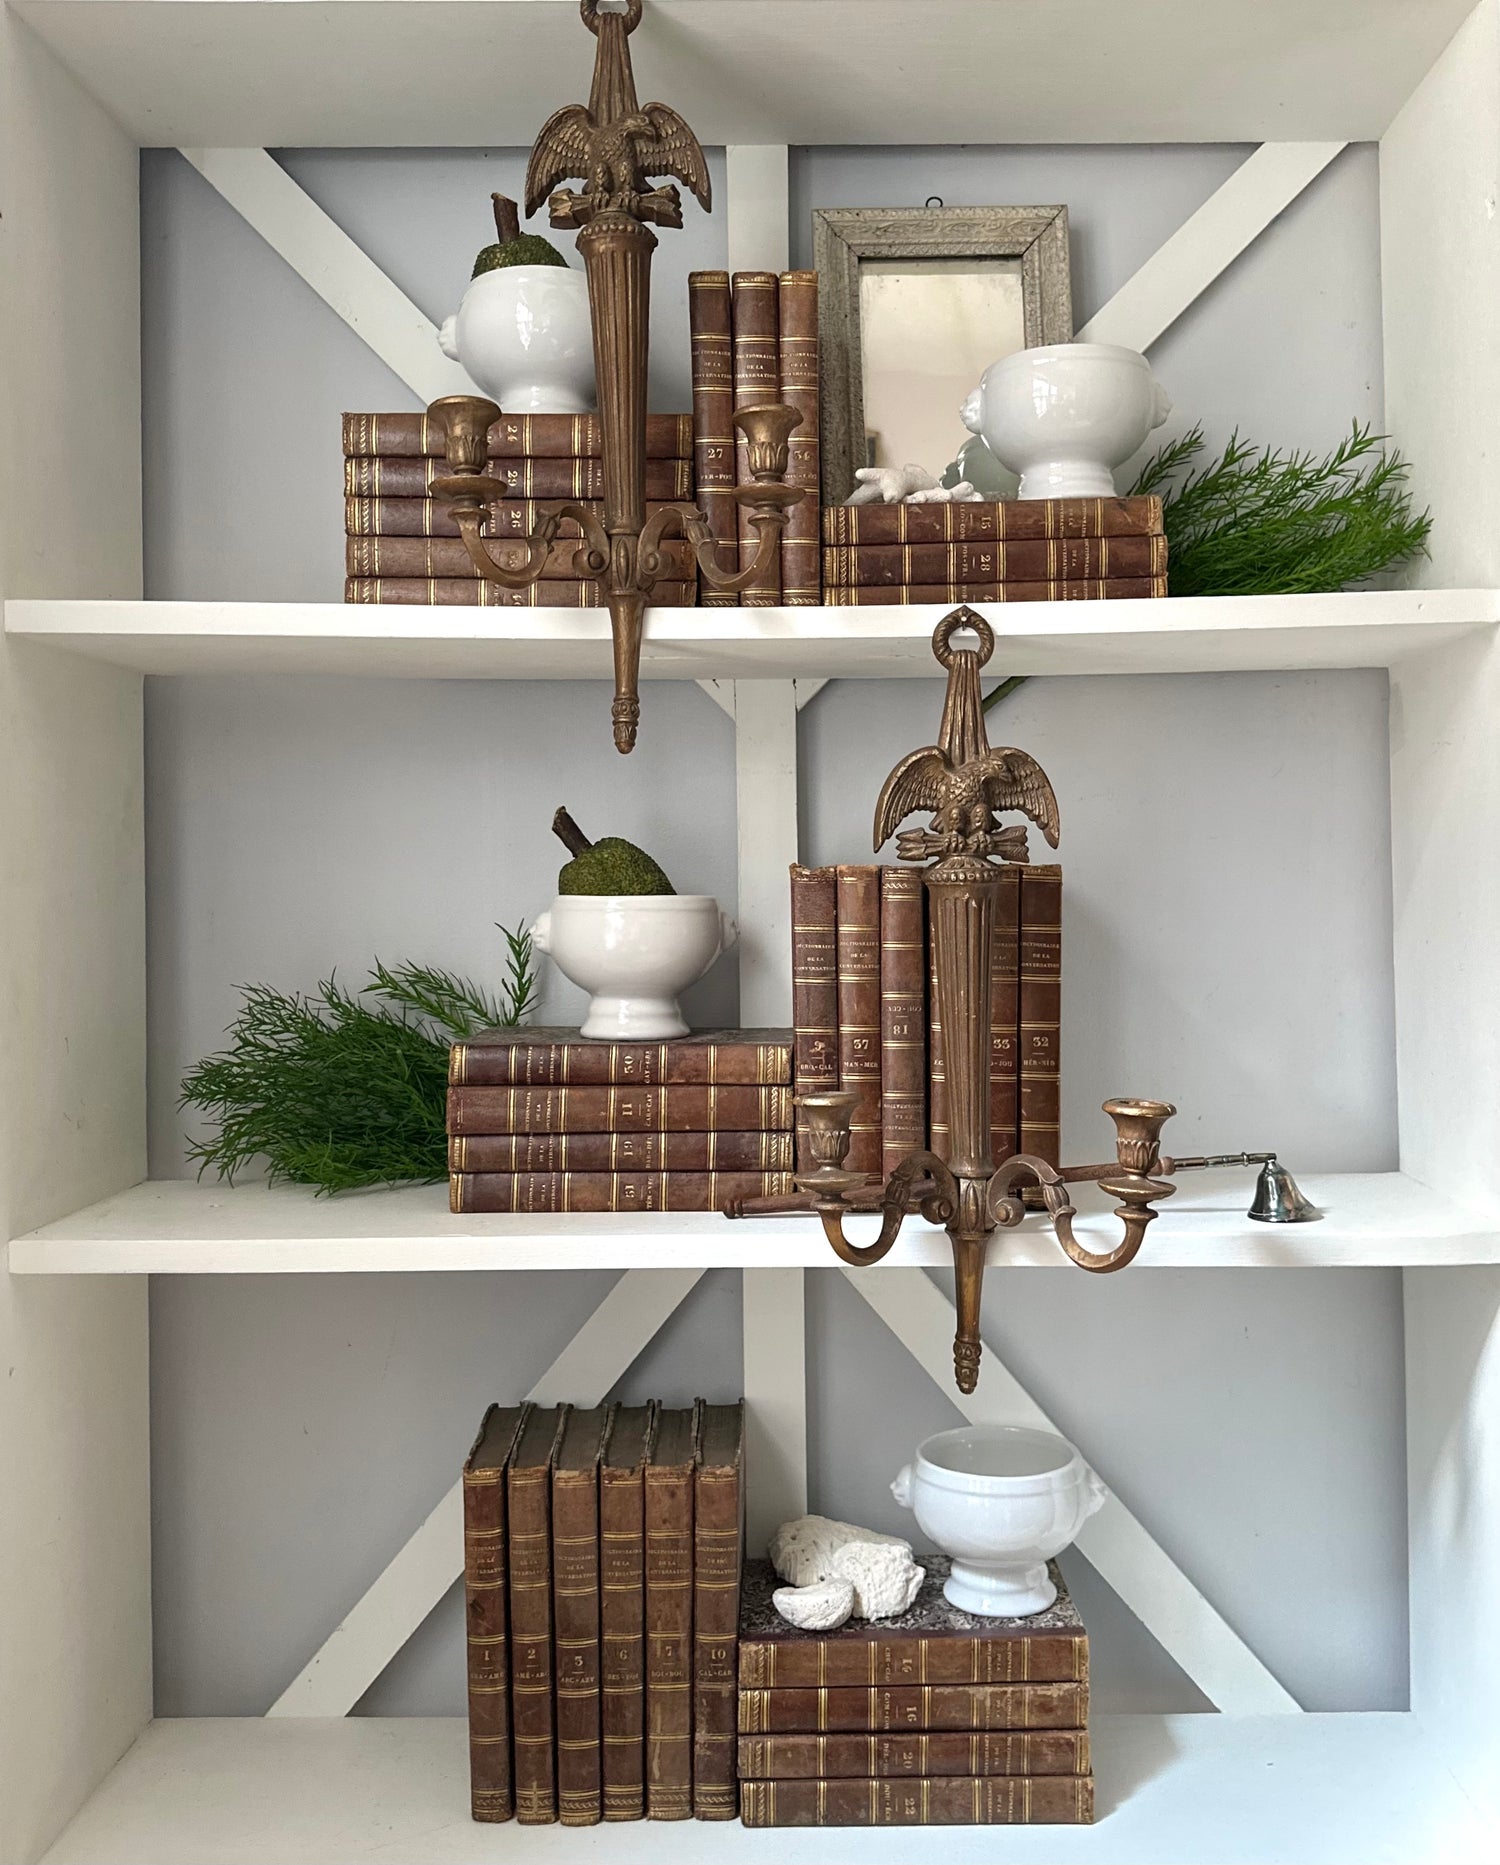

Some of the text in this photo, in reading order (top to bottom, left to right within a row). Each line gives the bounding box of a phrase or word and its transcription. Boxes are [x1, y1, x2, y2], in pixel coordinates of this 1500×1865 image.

[507, 425, 518, 442] 24
[707, 448, 723, 459] 27
[507, 470, 518, 487] 29
[511, 510, 522, 528] 26
[981, 516, 991, 529] 15
[980, 554, 991, 571] 28
[893, 1024, 908, 1035] 18
[814, 1040, 821, 1051] 9
[853, 1039, 869, 1049] 37
[993, 1038, 1010, 1050] 33
[1033, 1036, 1049, 1047] 32
[622, 1103, 632, 1116] 11
[623, 1141, 633, 1156] 19
[625, 1184, 635, 1198] 51
[484, 1650, 490, 1661] 1
[527, 1648, 536, 1659] 2
[619, 1649, 628, 1660] 6
[665, 1646, 672, 1657] 7
[710, 1649, 726, 1660] 10
[906, 1706, 917, 1722] 16
[903, 1752, 913, 1769] 20
[905, 1797, 916, 1815] 22
